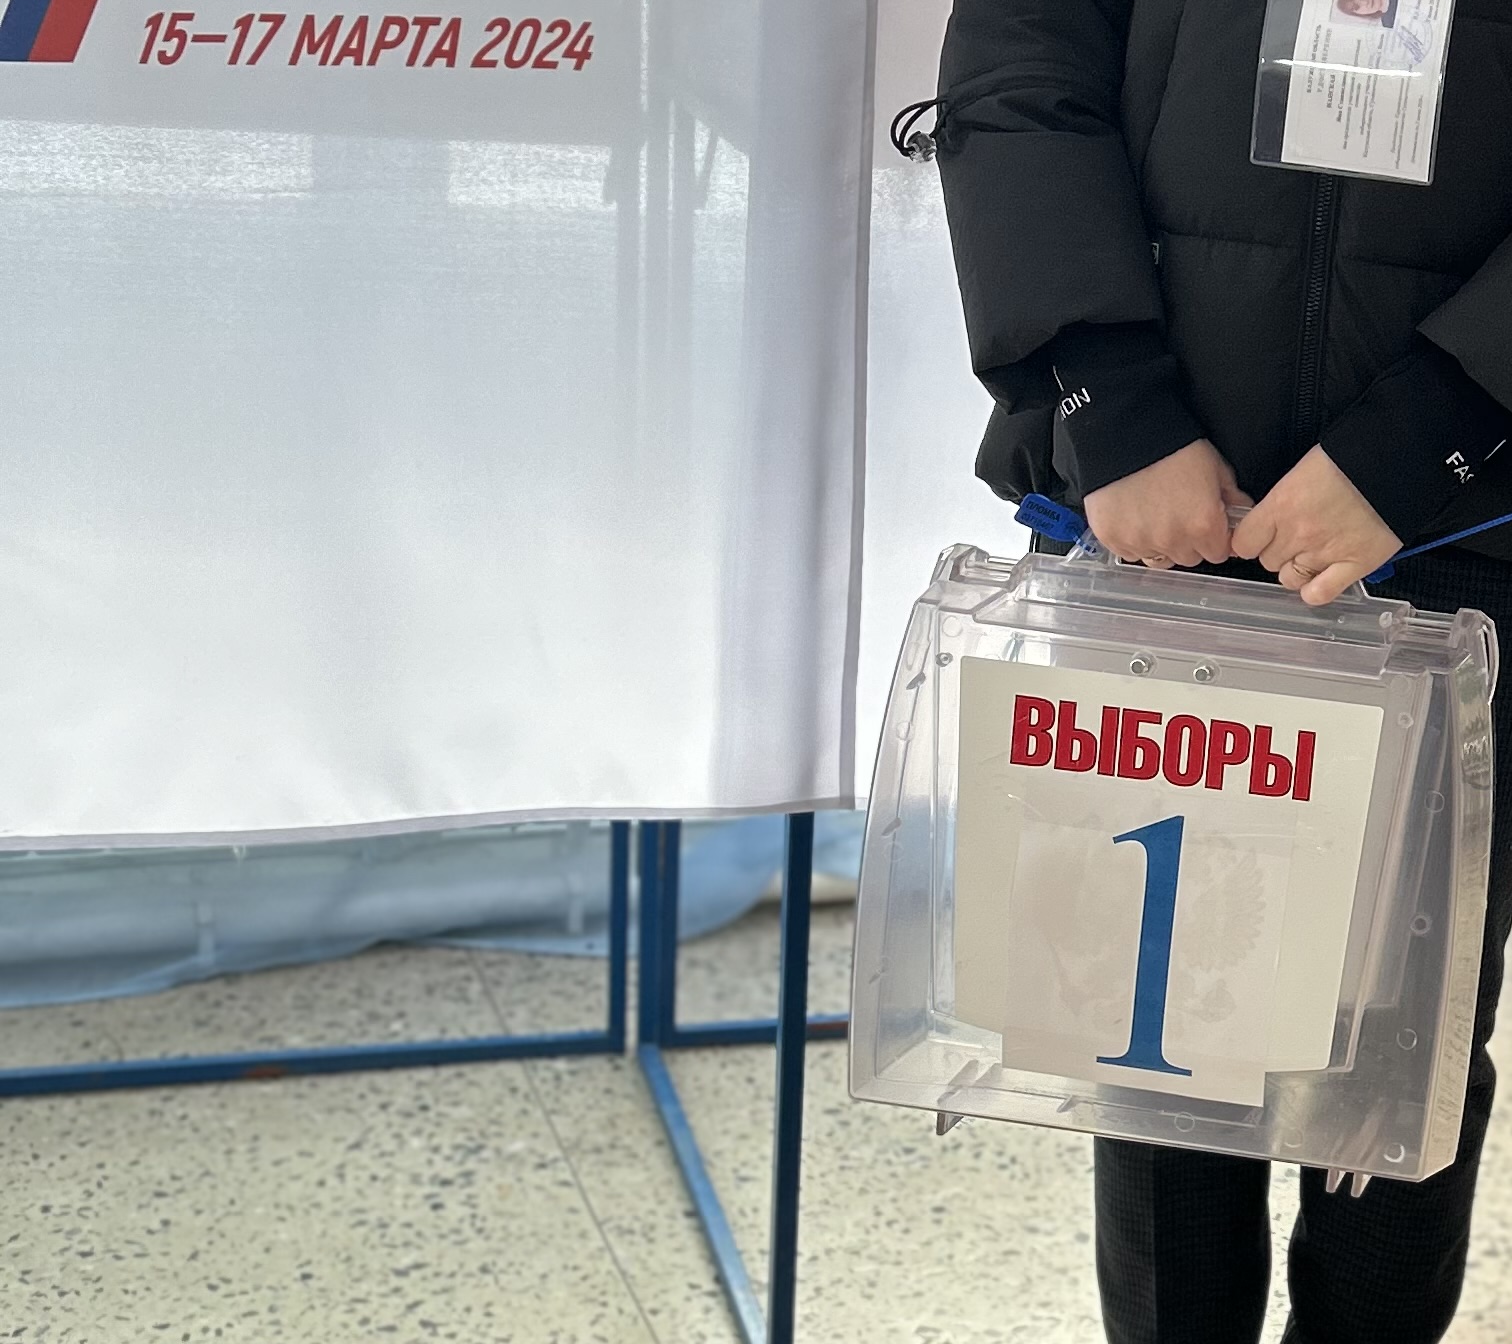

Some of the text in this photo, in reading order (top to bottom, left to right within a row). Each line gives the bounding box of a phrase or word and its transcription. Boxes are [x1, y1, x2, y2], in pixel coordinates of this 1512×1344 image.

[290, 15, 463, 68] МАРТА
[470, 19, 594, 72] 2024
[1059, 387, 1091, 421] ION
[1010, 695, 1316, 801] ВЫБОРЫ
[1096, 815, 1192, 1076] 1
